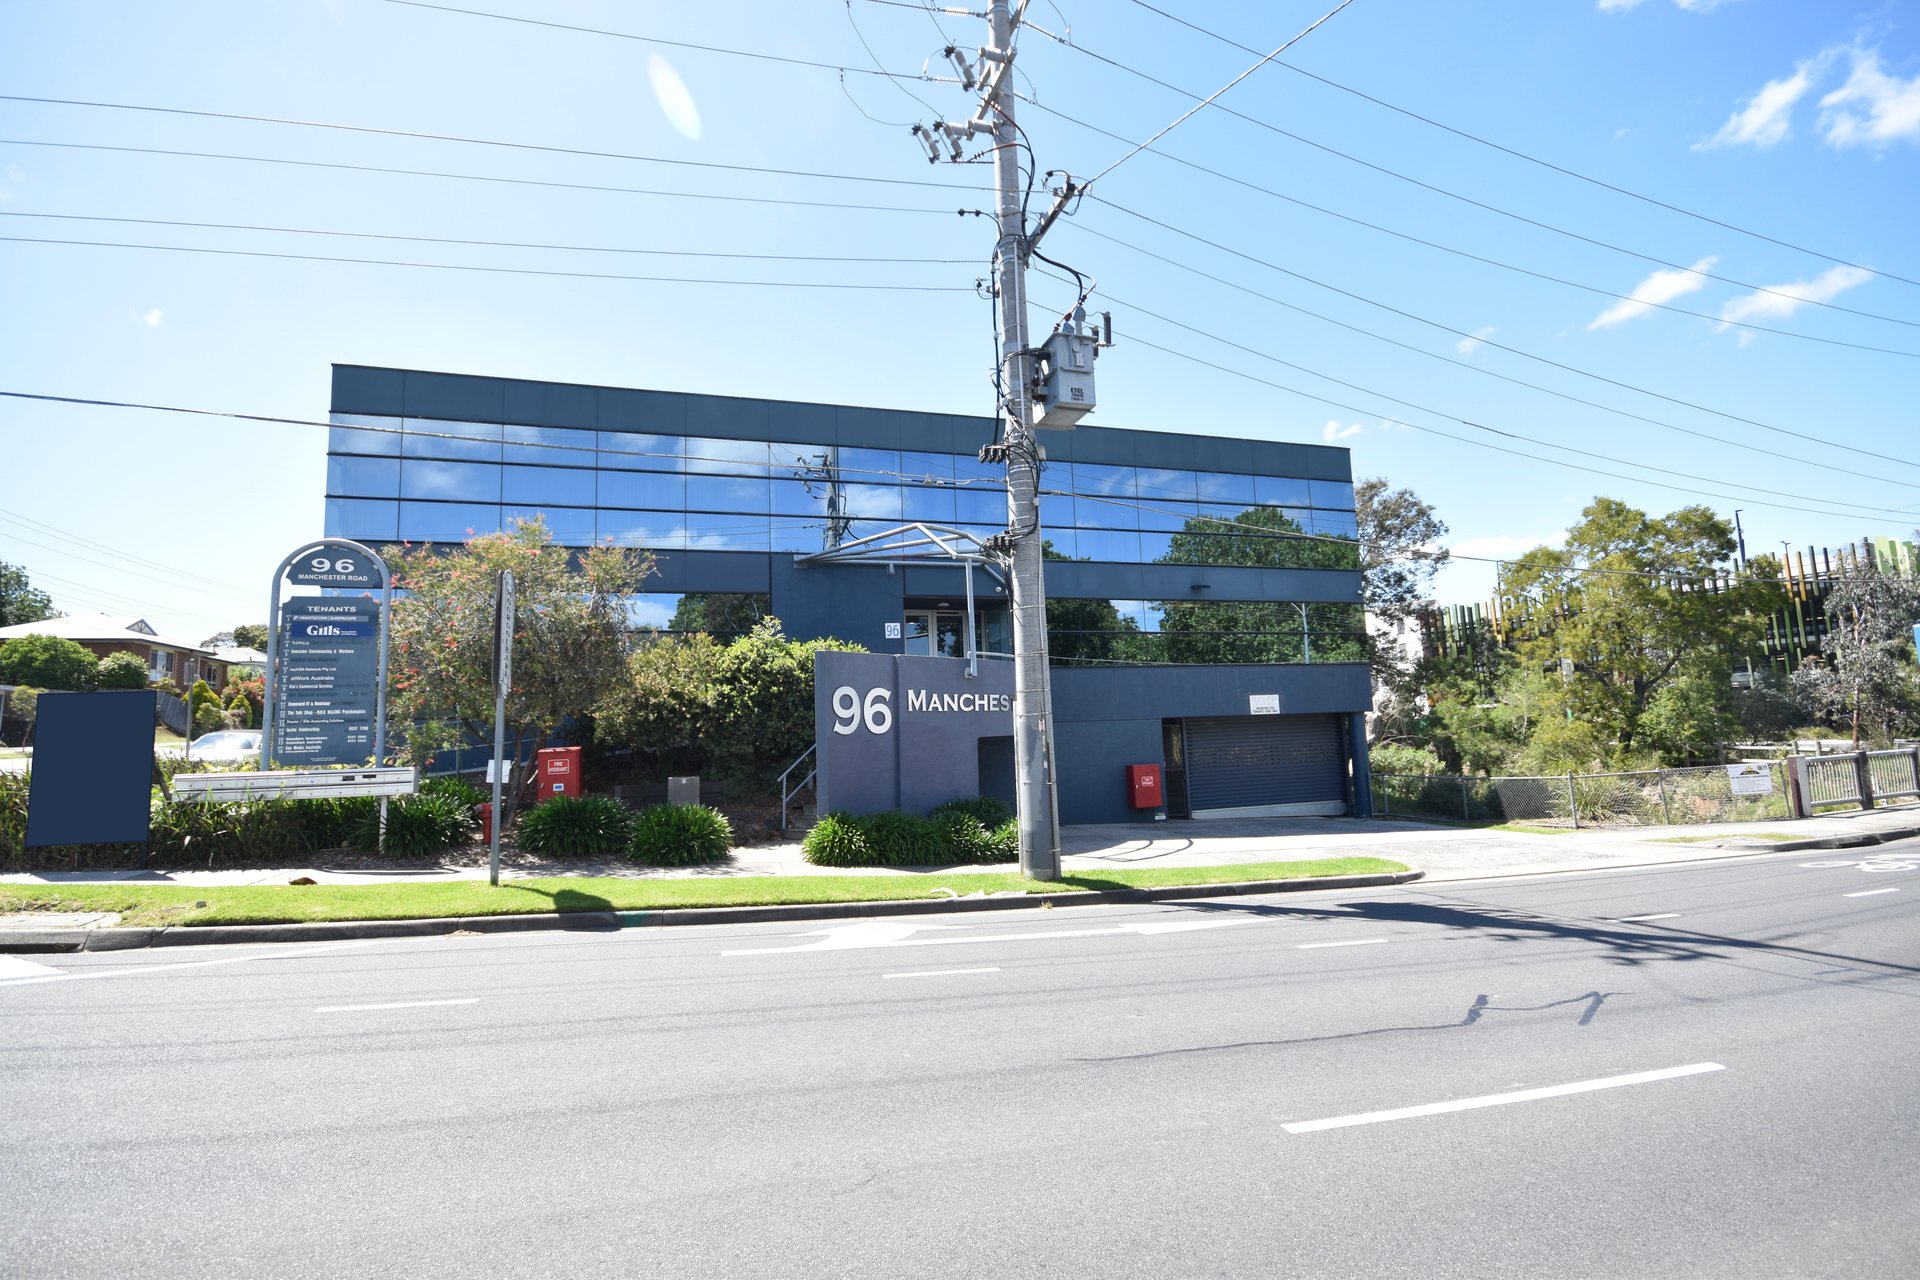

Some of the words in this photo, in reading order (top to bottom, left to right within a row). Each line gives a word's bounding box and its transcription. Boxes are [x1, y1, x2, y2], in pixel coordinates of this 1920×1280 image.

[311, 558, 355, 573] 96
[298, 573, 346, 581] MANCHESTER
[307, 605, 357, 613] TENANTS
[306, 625, 340, 636] Gills
[886, 624, 900, 638] 96
[907, 689, 1013, 712] MANCHES
[832, 685, 892, 735] 96
